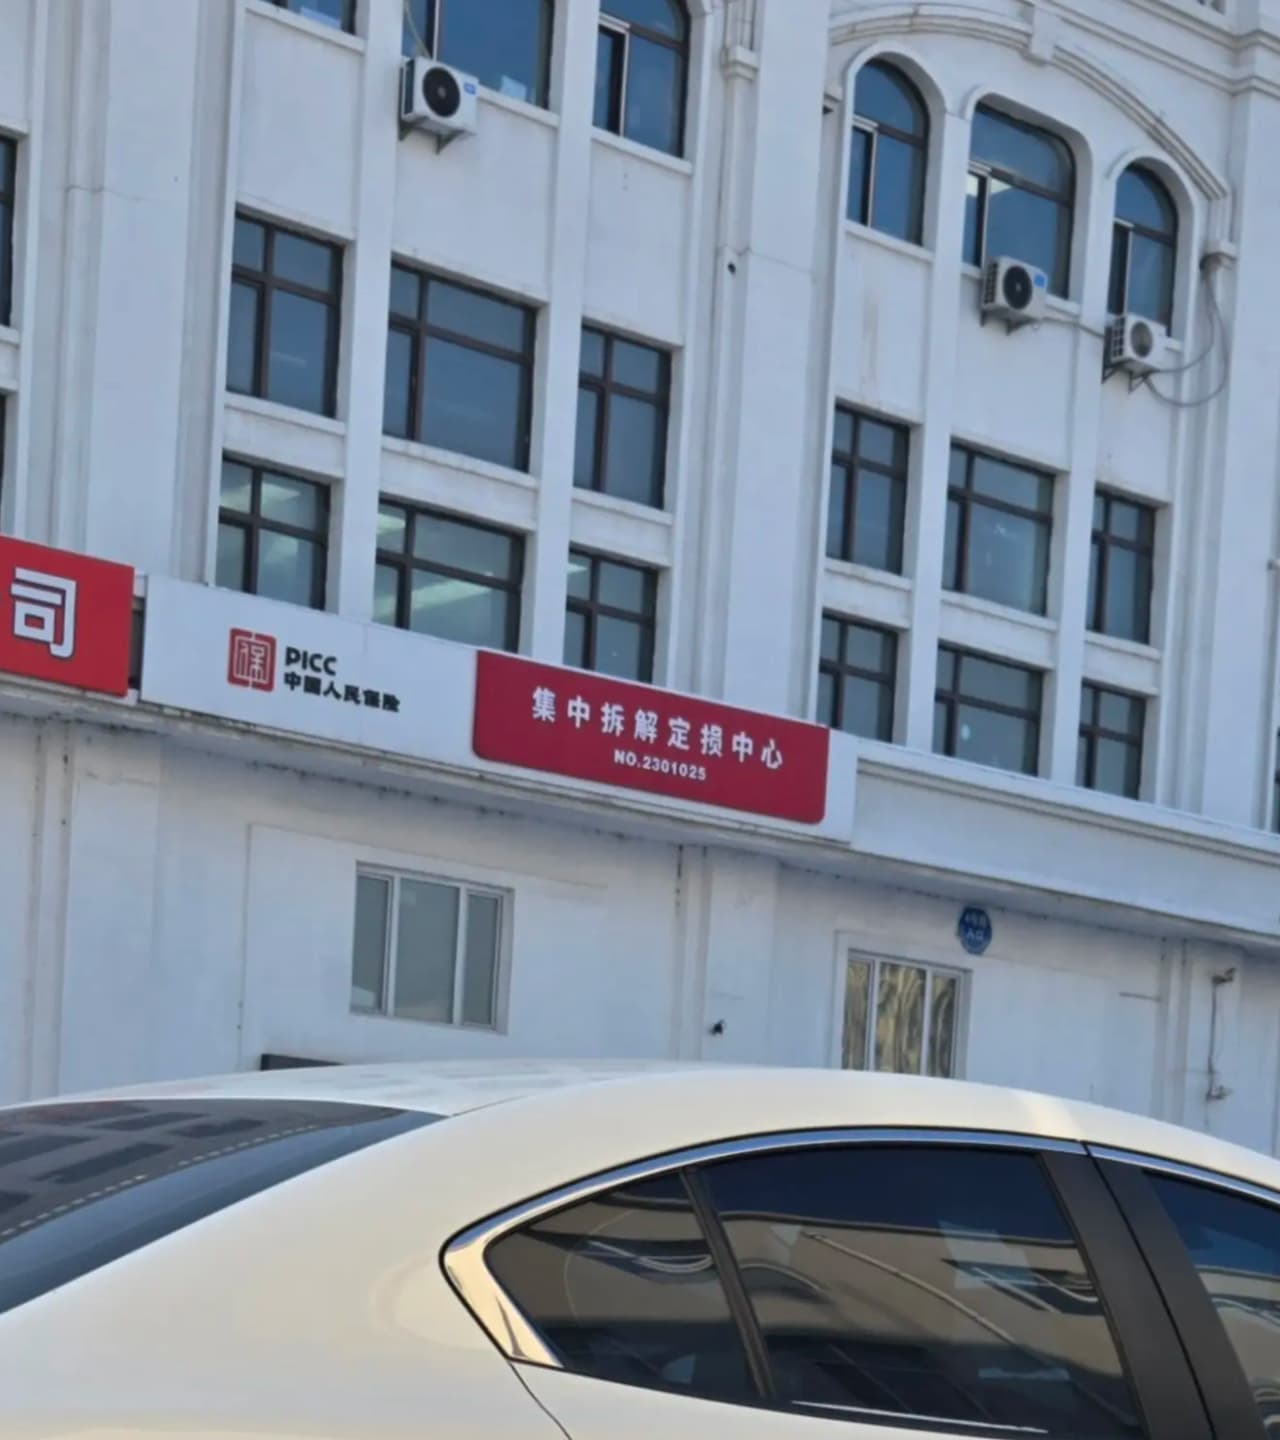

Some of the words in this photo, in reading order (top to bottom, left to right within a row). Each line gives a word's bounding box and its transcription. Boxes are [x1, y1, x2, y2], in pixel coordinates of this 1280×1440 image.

[285, 646, 338, 676] PICC
[531, 686, 784, 770] 集中拆解定损中心
[613, 749, 707, 781] NO.2301025
